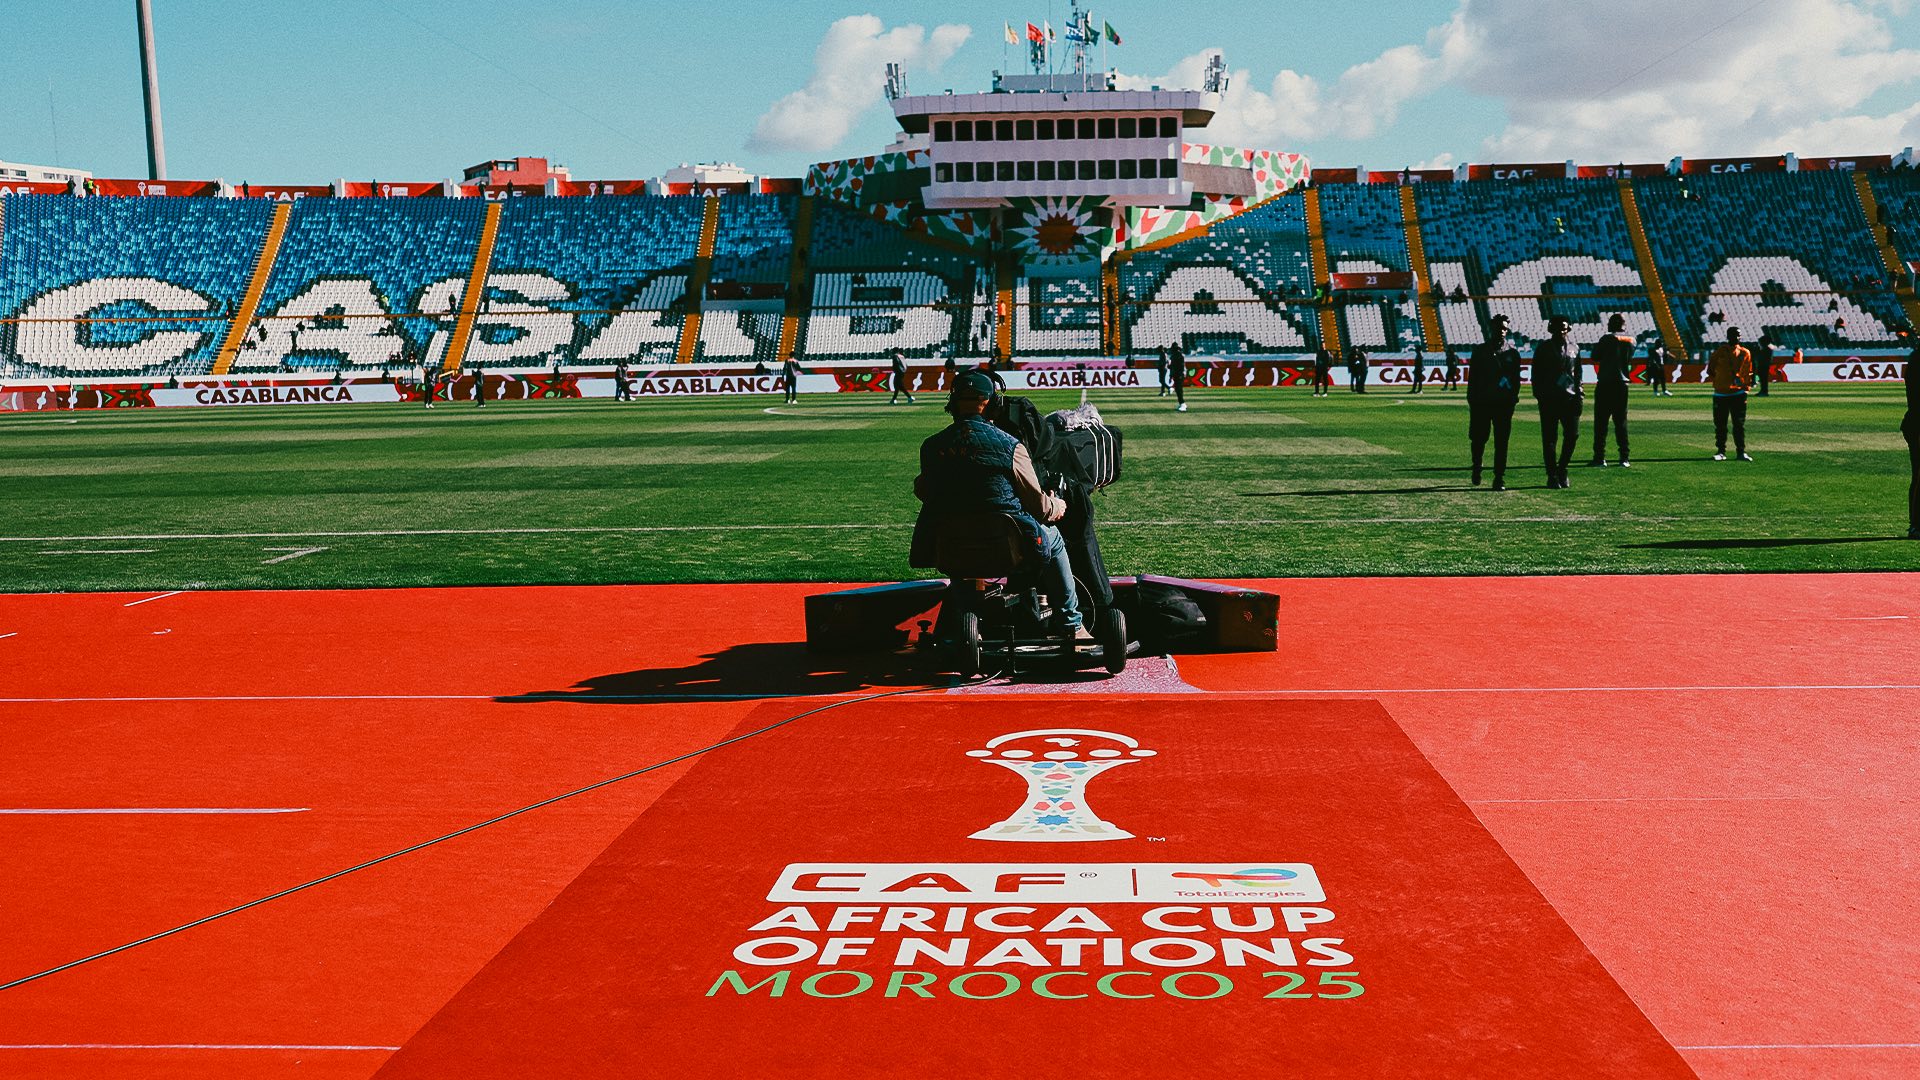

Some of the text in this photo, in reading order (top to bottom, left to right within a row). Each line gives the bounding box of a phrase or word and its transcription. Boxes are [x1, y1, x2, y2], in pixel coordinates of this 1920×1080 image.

[1709, 164, 1753, 174] CAF
[0, 186, 30, 198] AF
[1366, 276, 1378, 285] 23
[628, 376, 787, 395] CASABLANCA
[1026, 370, 1140, 387] CASABLANCA
[195, 386, 353, 405] CASABLANCA
[791, 872, 1066, 893] CAF
[1173, 890, 1306, 898] TotalEnergies
[747, 906, 1336, 933] AFRICA CUP
[732, 936, 1354, 967] OF NATIONS
[704, 970, 1365, 1000] MOROCCO 25
